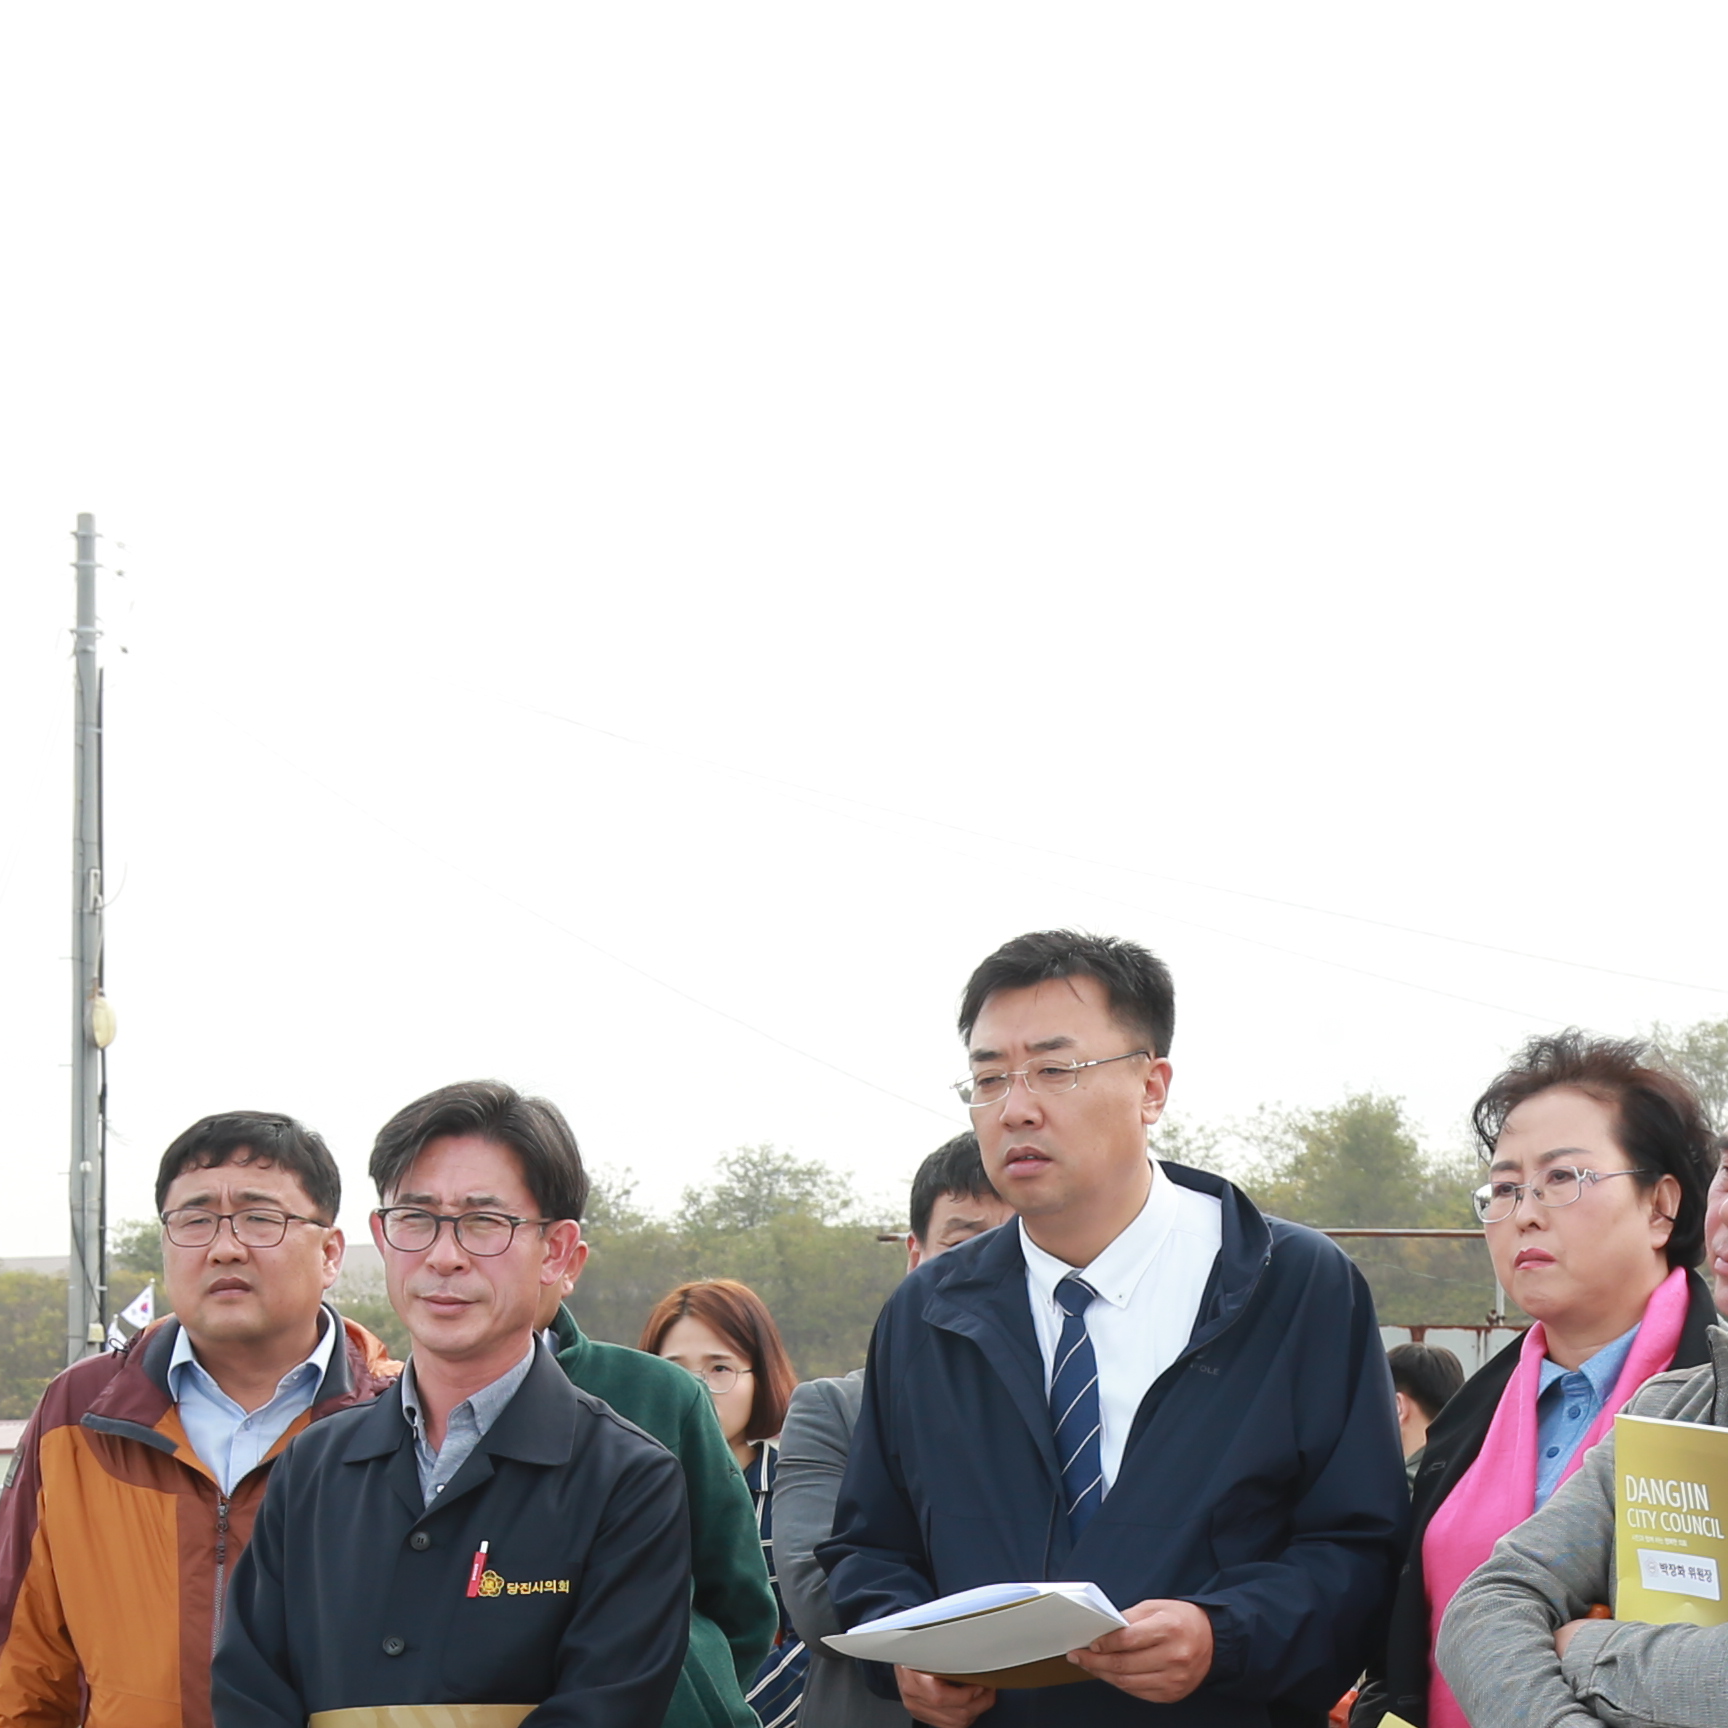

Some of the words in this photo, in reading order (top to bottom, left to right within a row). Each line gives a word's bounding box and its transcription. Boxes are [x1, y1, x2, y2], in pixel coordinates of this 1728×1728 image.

[1625, 1474, 1710, 1513] DANGJIN
[1626, 1507, 1657, 1530] CITY
[1660, 1511, 1725, 1540] COUNCIL
[506, 1579, 570, 1596] 당진시의회
